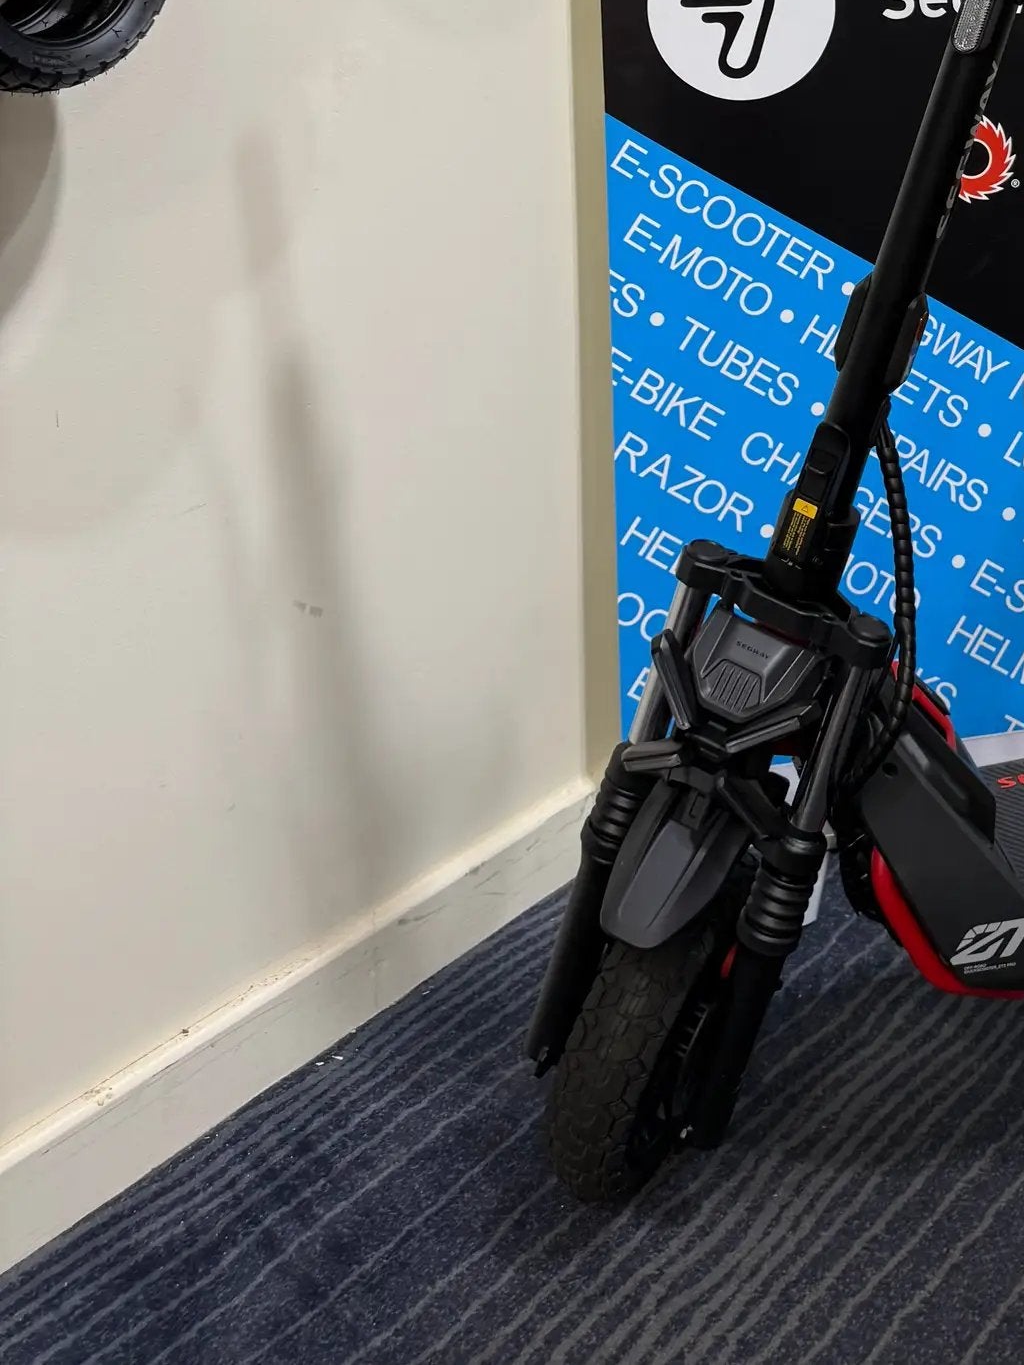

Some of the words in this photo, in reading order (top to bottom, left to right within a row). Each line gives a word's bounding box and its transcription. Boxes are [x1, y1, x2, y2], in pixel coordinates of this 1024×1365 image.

[610, 139, 835, 291] E-SCOOTER
[622, 212, 773, 316] E-MOTO
[677, 315, 799, 406] TUBES
[613, 431, 754, 533] RAZOR
[736, 640, 771, 660] SEGWAY
